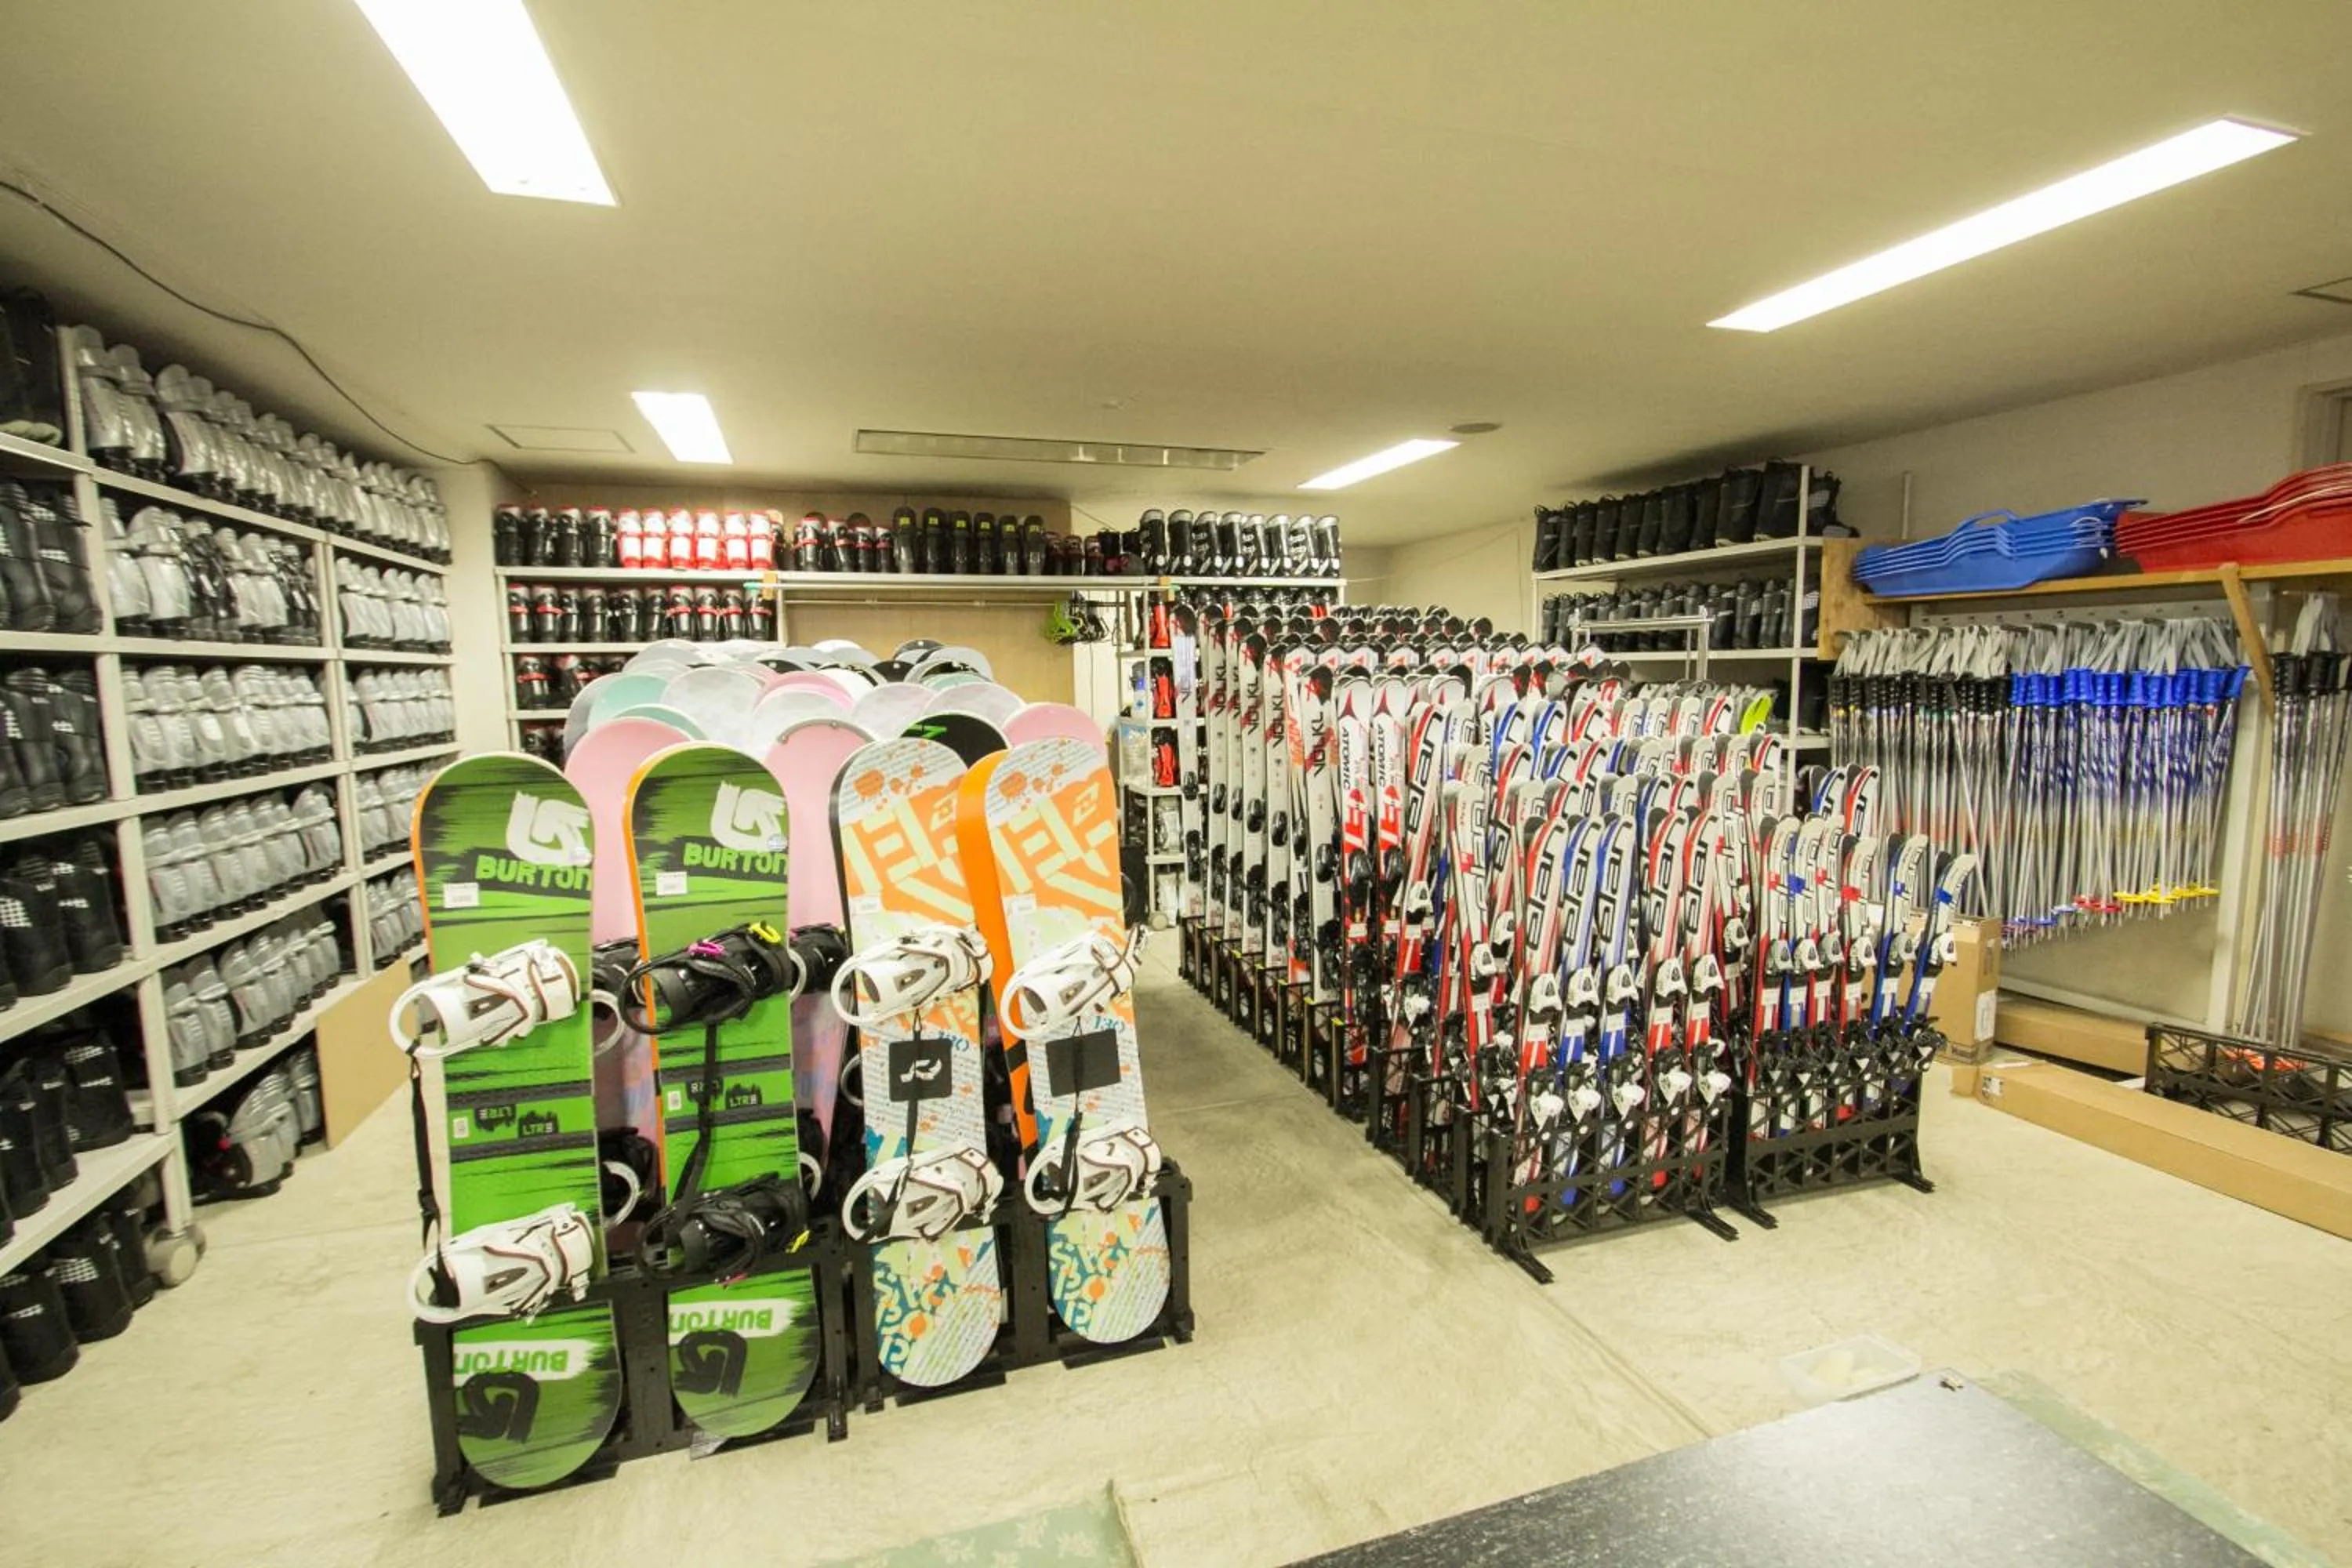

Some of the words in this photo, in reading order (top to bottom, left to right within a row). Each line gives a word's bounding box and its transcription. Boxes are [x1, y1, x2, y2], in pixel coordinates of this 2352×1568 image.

[1341, 726, 1352, 791] ATOMIC
[1377, 724, 1386, 788] ATOMIC
[475, 854, 593, 891] BURTON
[683, 841, 788, 876] BURTON
[669, 1308, 774, 1334] BURTON
[454, 1341, 568, 1374] BURTON
